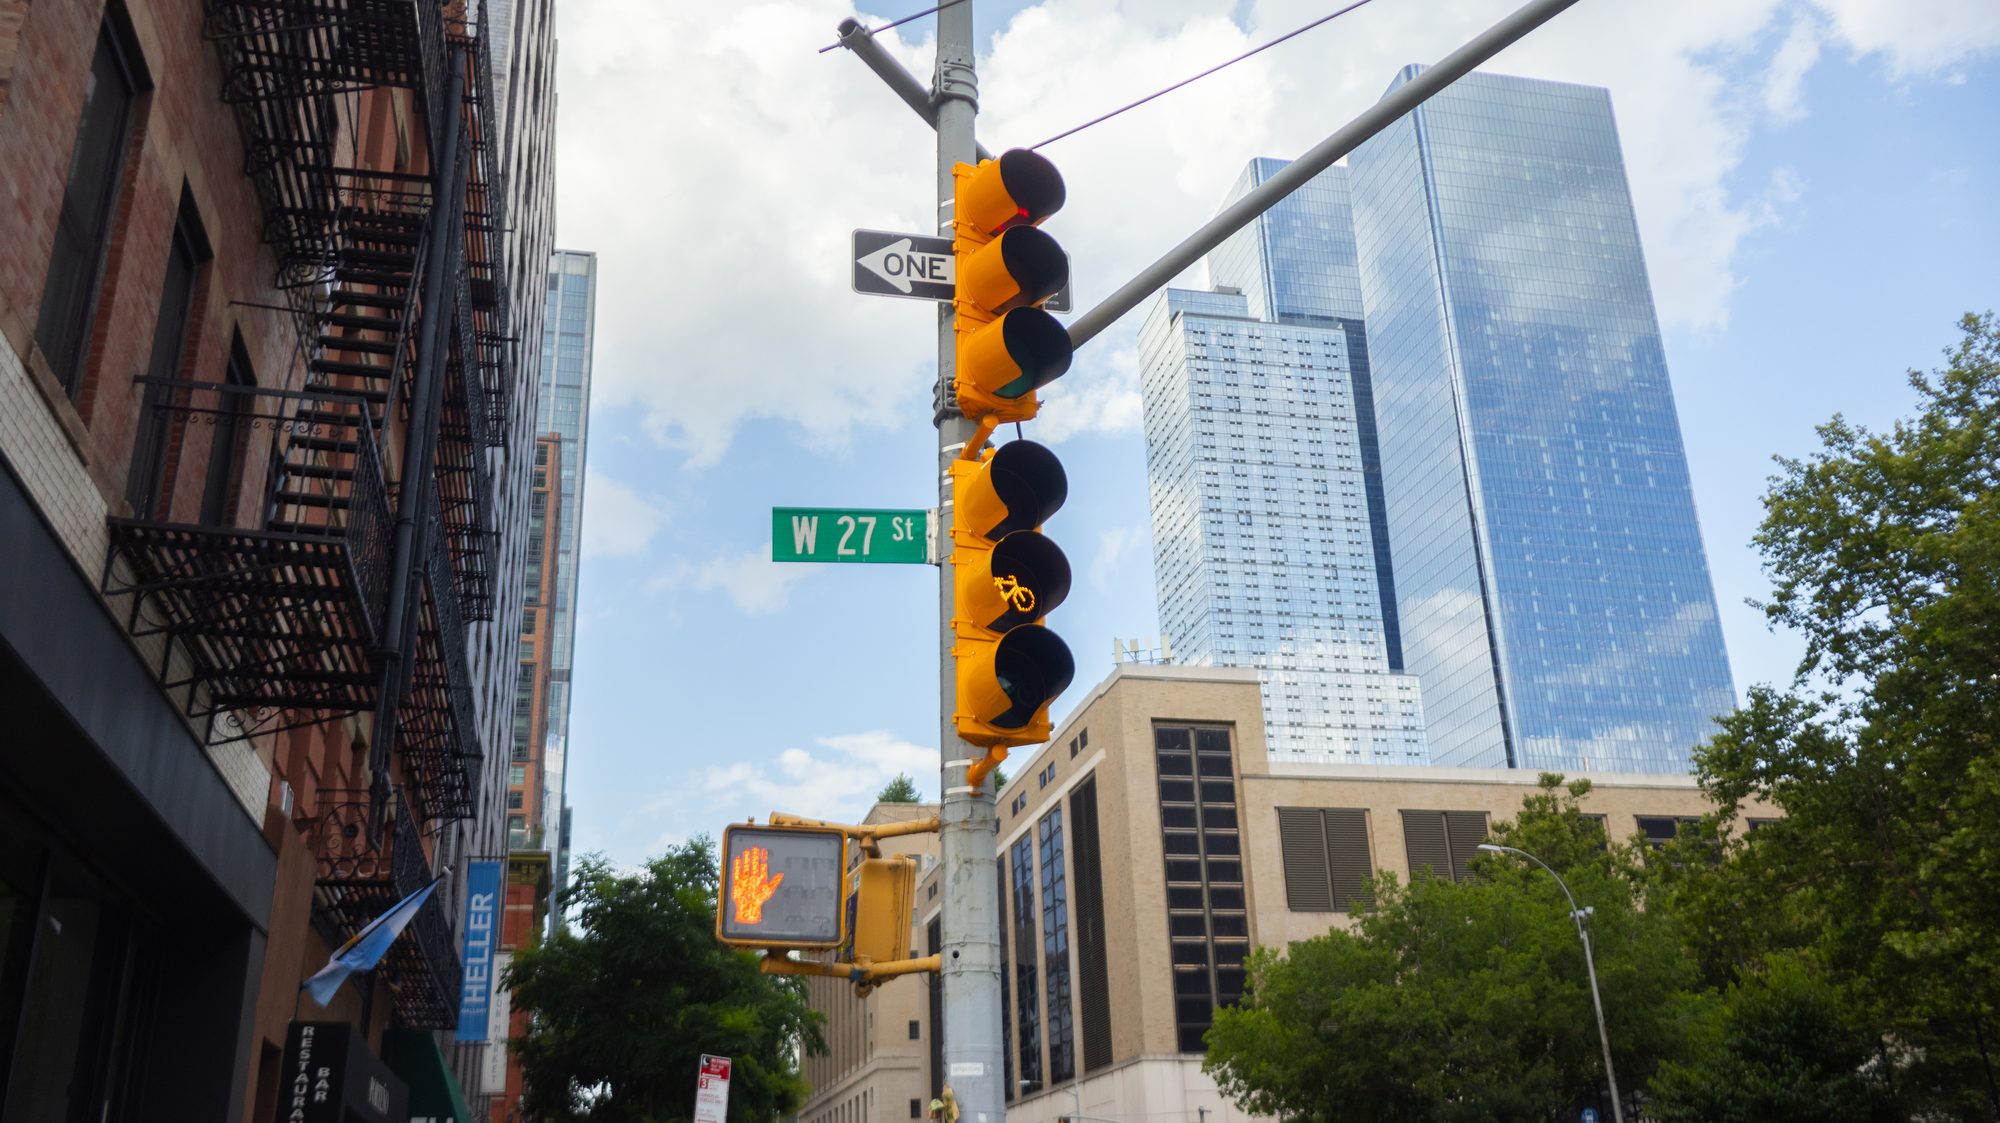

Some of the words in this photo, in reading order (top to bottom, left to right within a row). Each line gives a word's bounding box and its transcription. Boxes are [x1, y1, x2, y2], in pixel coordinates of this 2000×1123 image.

[883, 252, 947, 281] ONE
[792, 515, 818, 555] W
[837, 515, 877, 555] 27
[892, 516, 913, 541] St
[464, 892, 493, 1004] HELLER
[314, 1067, 331, 1102] BAR
[702, 1079, 707, 1087] 3
